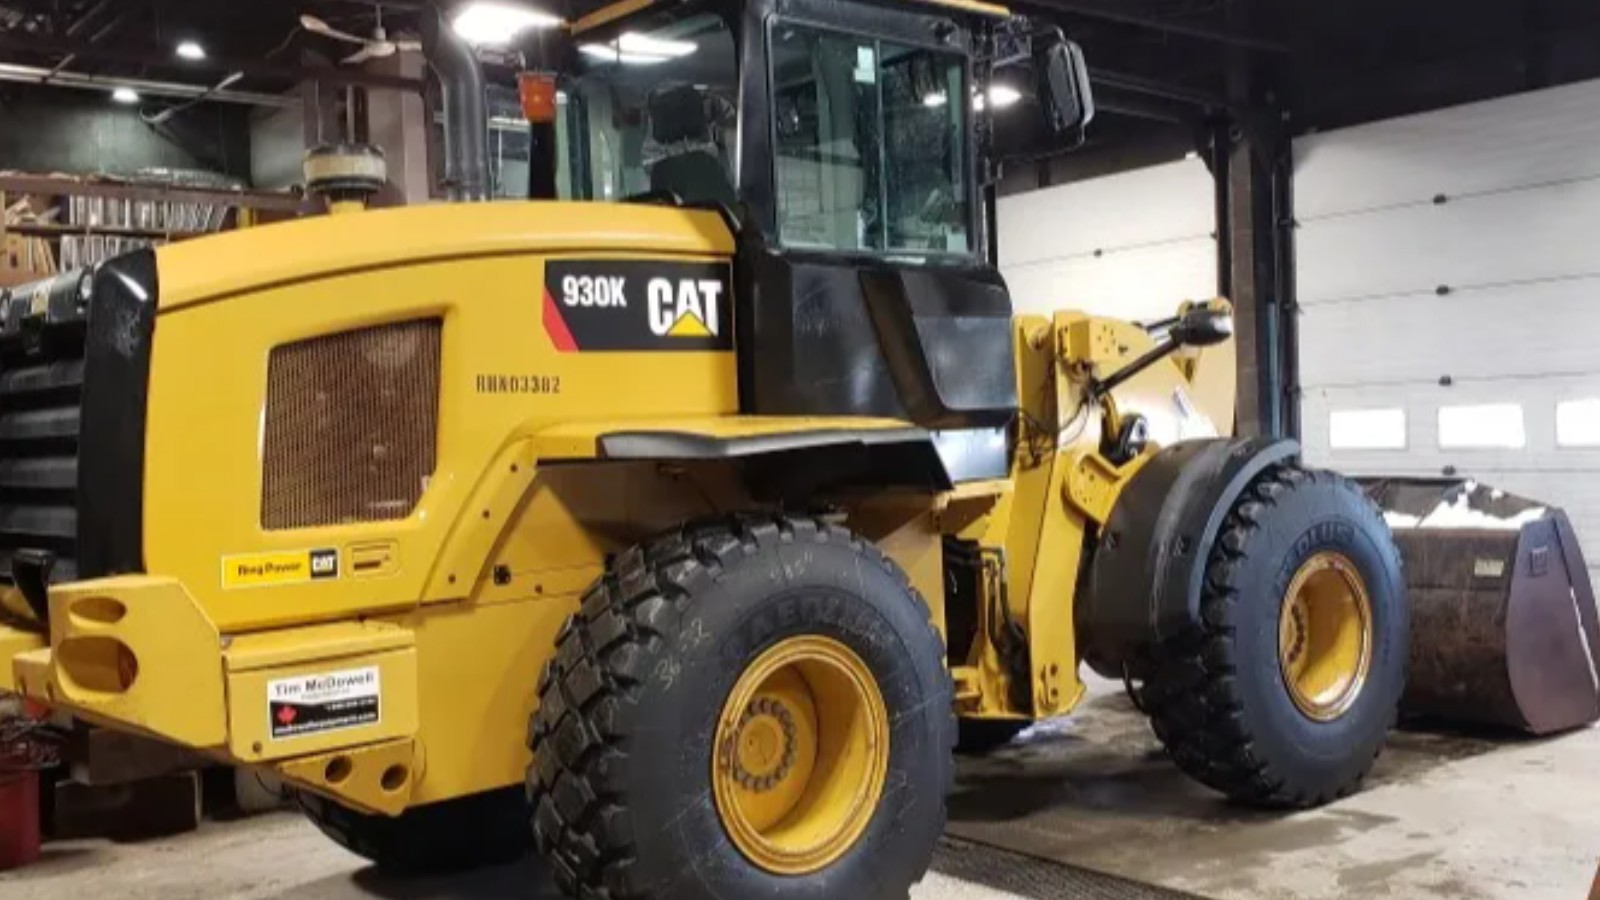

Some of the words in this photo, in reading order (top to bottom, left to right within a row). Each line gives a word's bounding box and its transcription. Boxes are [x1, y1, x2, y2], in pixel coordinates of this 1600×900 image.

[562, 274, 627, 308] 930K
[647, 277, 722, 337] CAT
[312, 555, 334, 572] CAT
[274, 683, 301, 697] Tim
